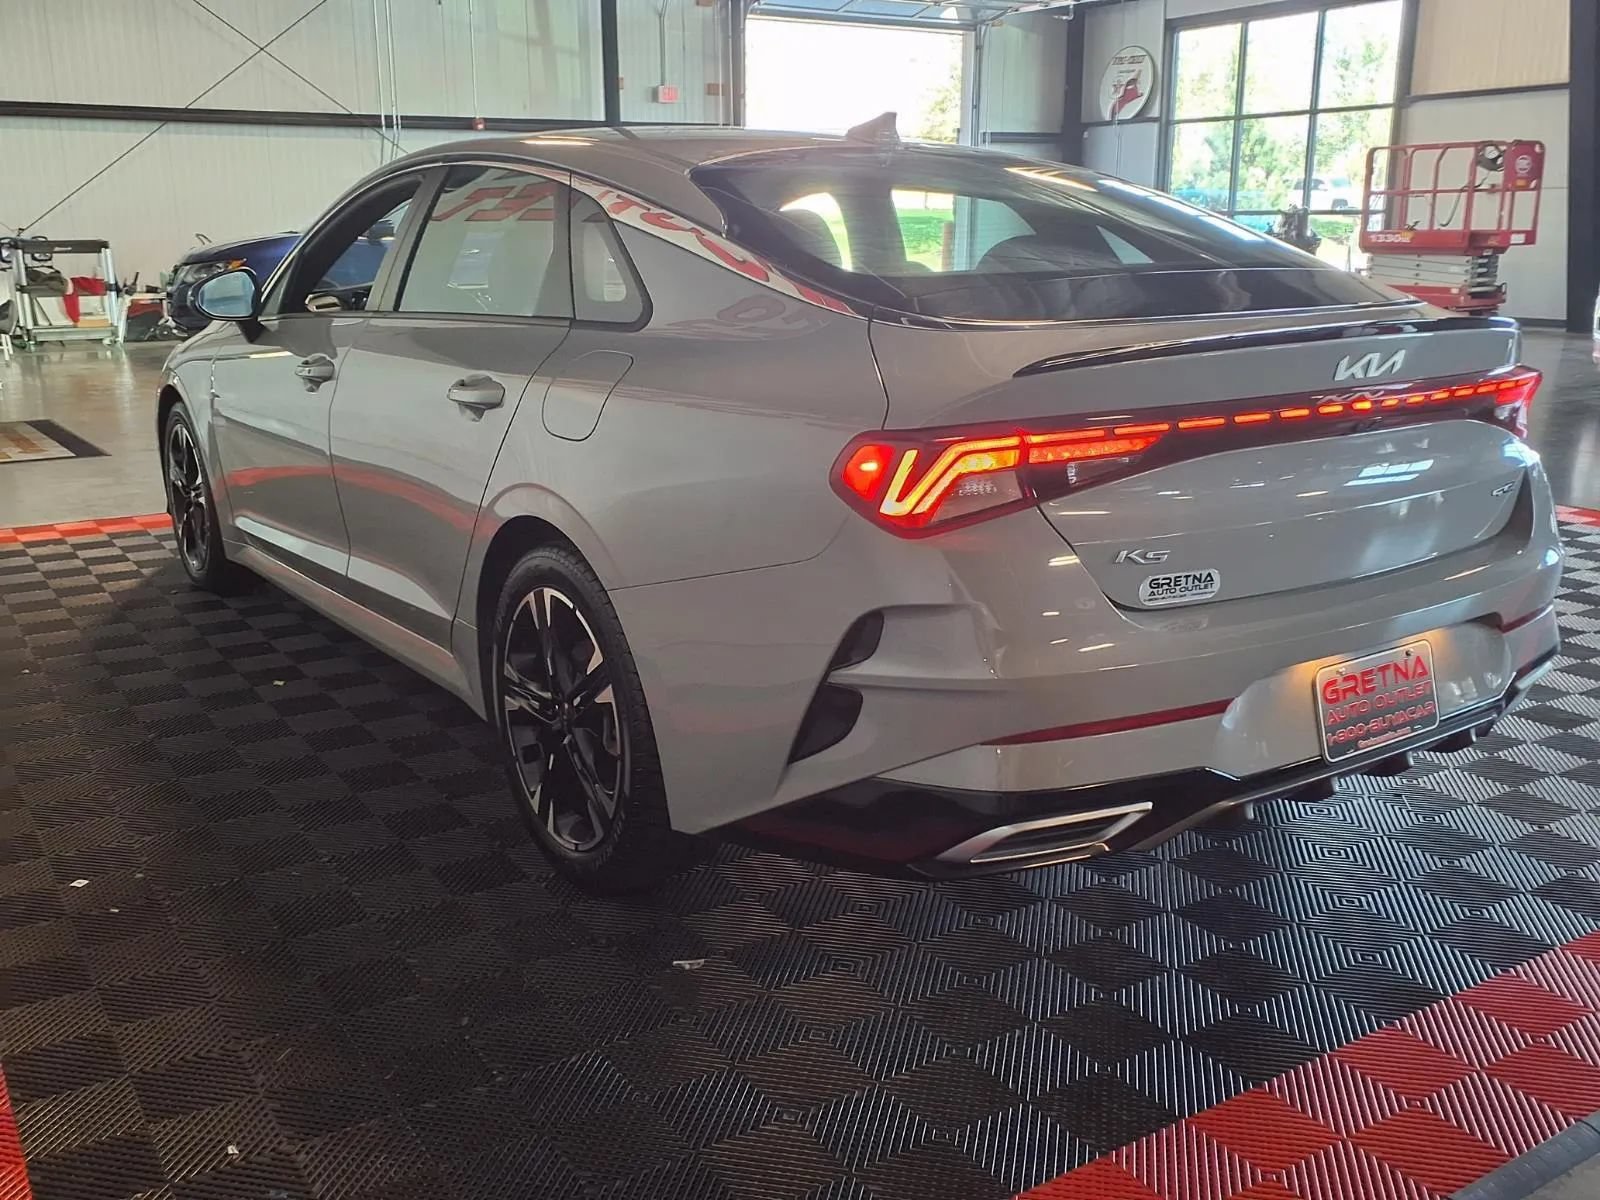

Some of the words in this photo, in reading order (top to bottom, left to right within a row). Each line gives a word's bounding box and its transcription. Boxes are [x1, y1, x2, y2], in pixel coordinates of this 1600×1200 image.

[1334, 349, 1406, 382] KIA
[1114, 549, 1171, 565] K5
[1148, 572, 1215, 590] GRETNA
[1148, 587, 1177, 597] AUTO
[1179, 582, 1215, 592] OUTLET
[1322, 655, 1429, 705] GRETNA
[1326, 699, 1370, 726] AUTO
[1374, 679, 1432, 709] OUTLET
